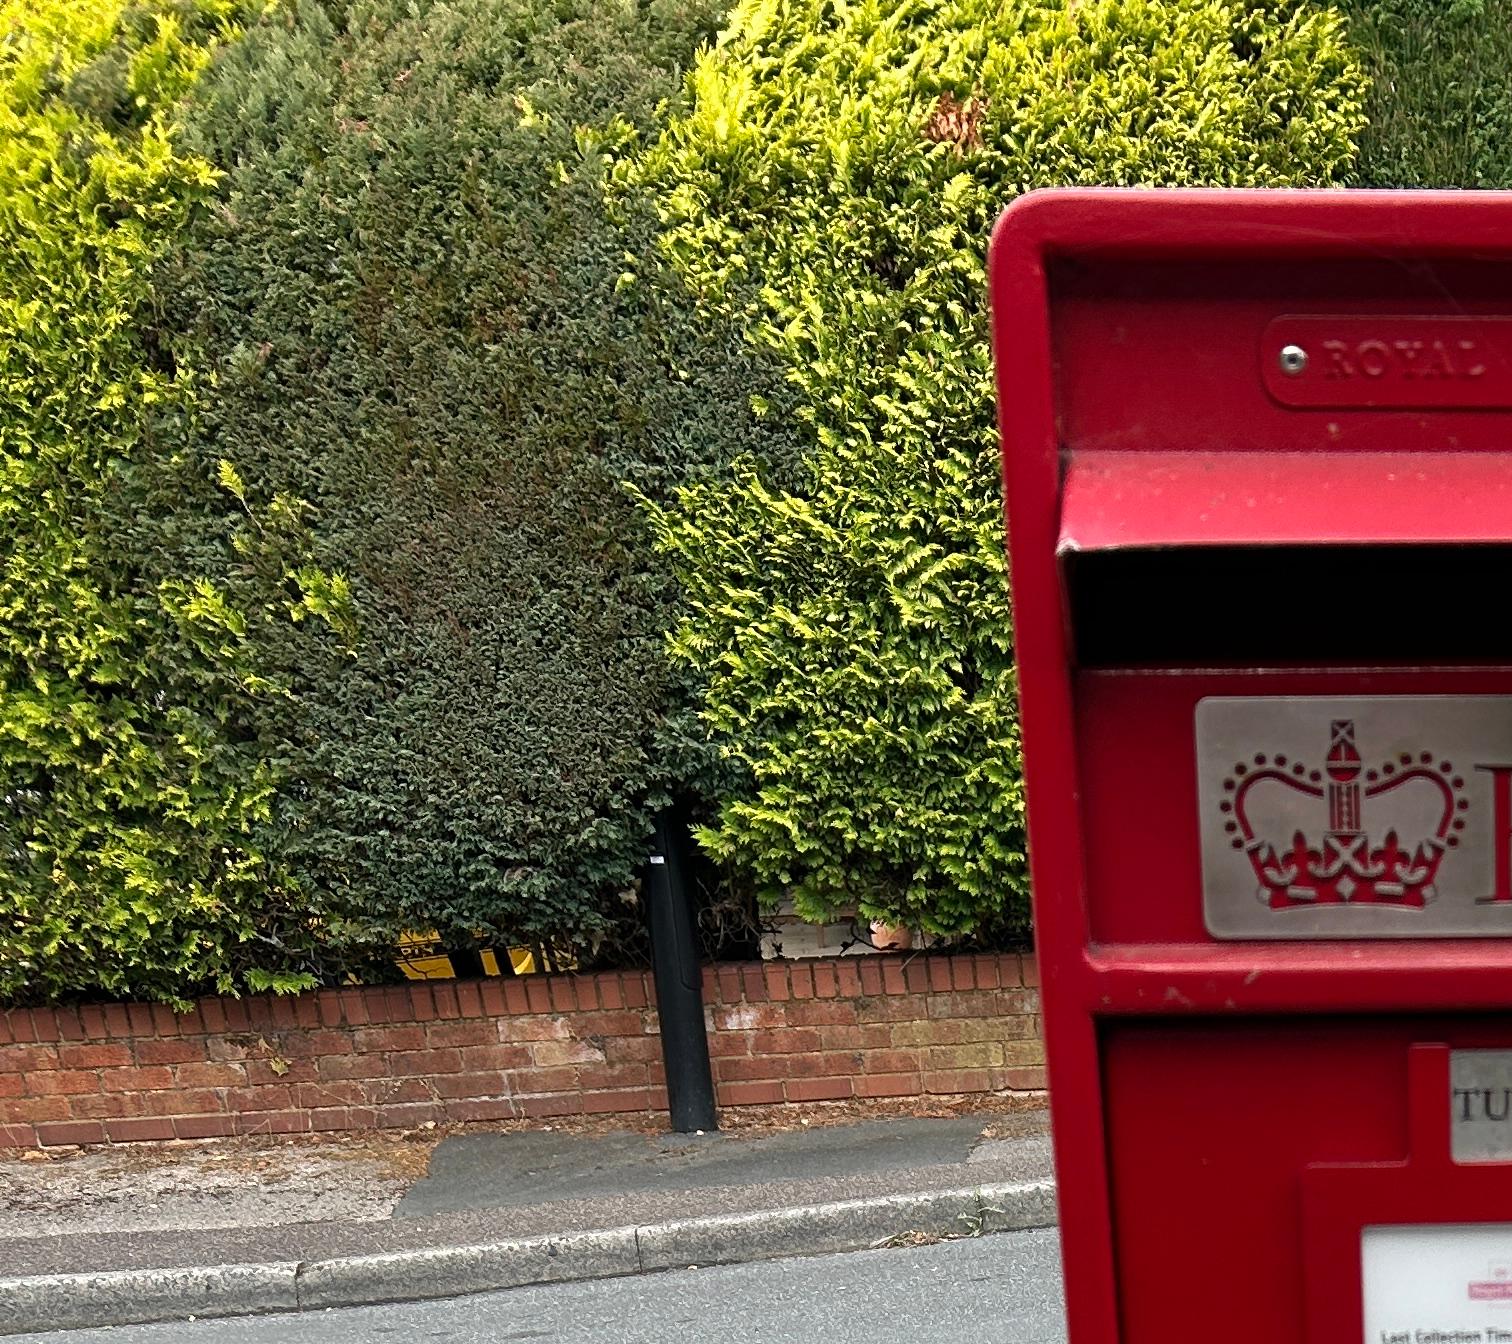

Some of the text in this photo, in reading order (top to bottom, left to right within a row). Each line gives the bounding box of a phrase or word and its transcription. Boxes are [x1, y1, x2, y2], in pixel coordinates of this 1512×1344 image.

[1320, 338, 1487, 377] ROYAL
[1382, 1330, 1410, 1344] Last
[1415, 1328, 1481, 1344] Collection
